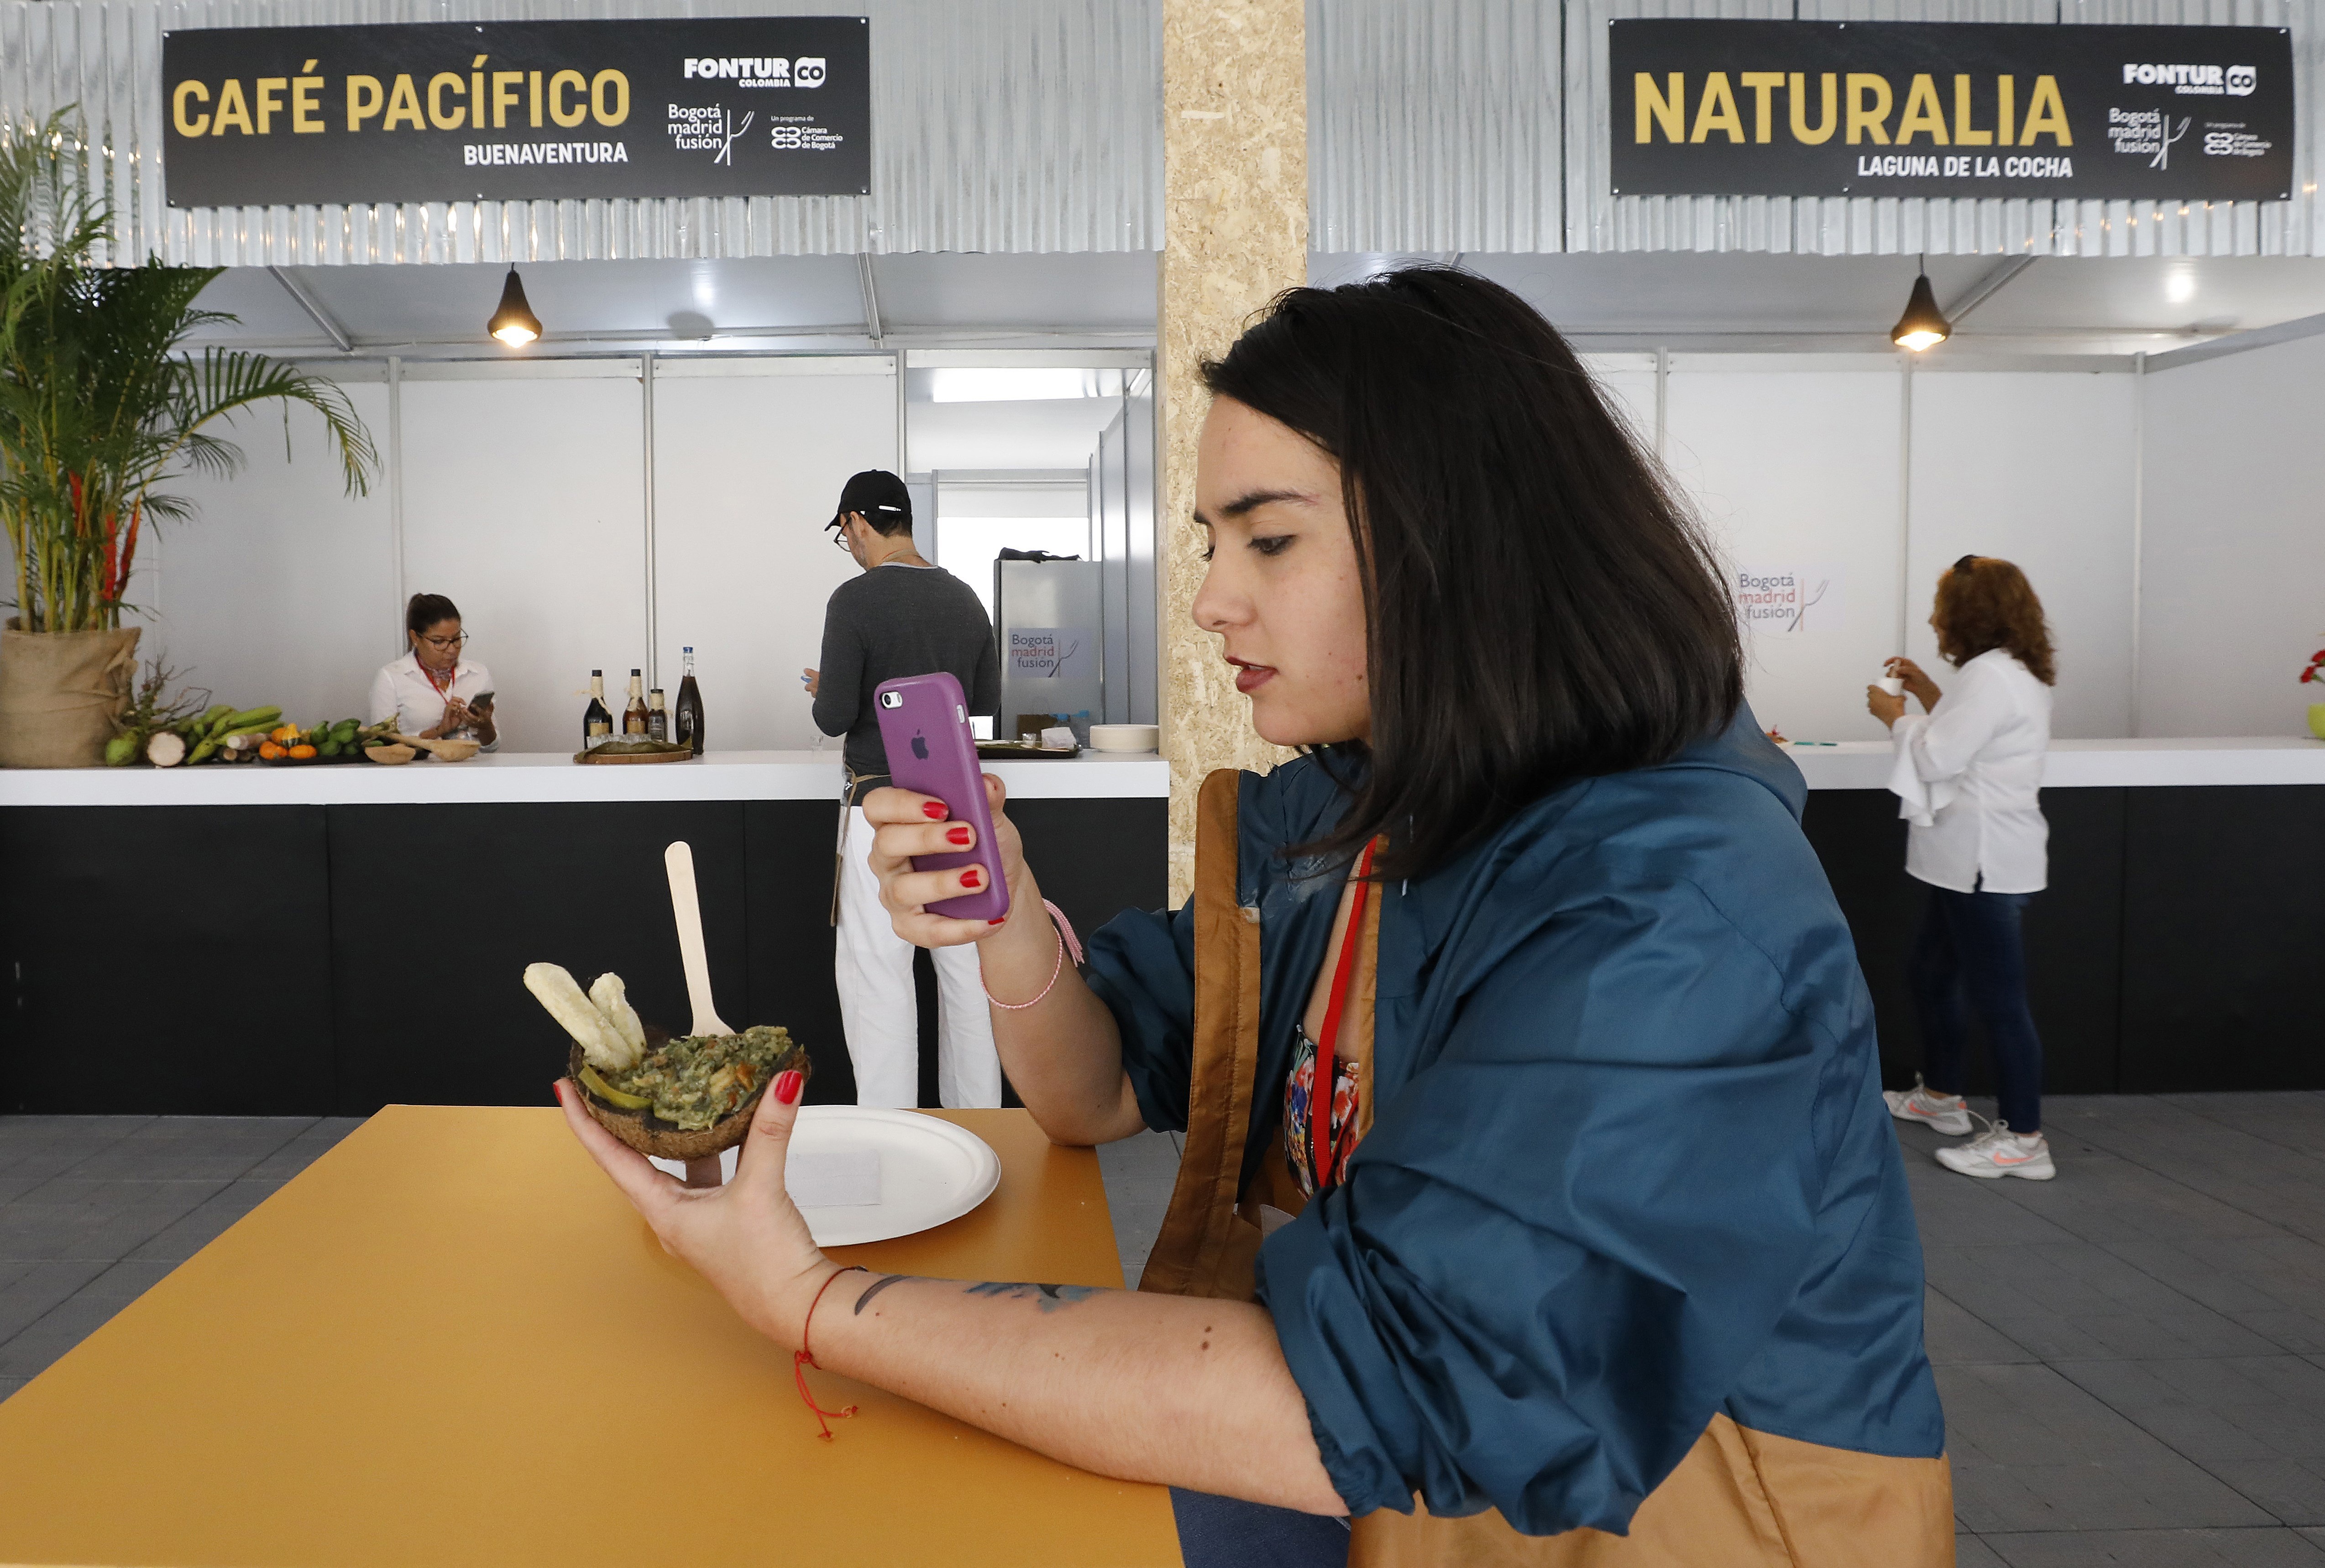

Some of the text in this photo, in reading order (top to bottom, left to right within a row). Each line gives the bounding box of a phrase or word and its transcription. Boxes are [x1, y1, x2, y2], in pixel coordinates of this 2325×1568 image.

[684, 57, 791, 79] FONTUR
[797, 66, 823, 80] CO
[2123, 63, 2224, 85] FONTUR
[738, 78, 791, 88] COLOMBIA
[173, 54, 630, 138] CAFÉ PACÍFICO
[668, 103, 721, 122] Bogotá
[1635, 72, 2073, 146] NATURALIA
[2109, 107, 2161, 127] Bogotá
[668, 120, 722, 135] madrid
[2108, 125, 2161, 139] madrid
[676, 134, 722, 149] fusión
[812, 141, 835, 151] Bogotá
[2115, 138, 2160, 153] fusión
[464, 142, 628, 166] BUENAVENTURA
[1858, 156, 2073, 178] LAGUNA DE LA COCHA
[1740, 572, 1794, 591] Bogotá
[1738, 588, 1796, 604] madrid
[1746, 604, 1796, 618] fusión
[1012, 633, 1053, 648] Bogotá
[1011, 646, 1054, 657] madrid
[1018, 657, 1054, 668] fusión
